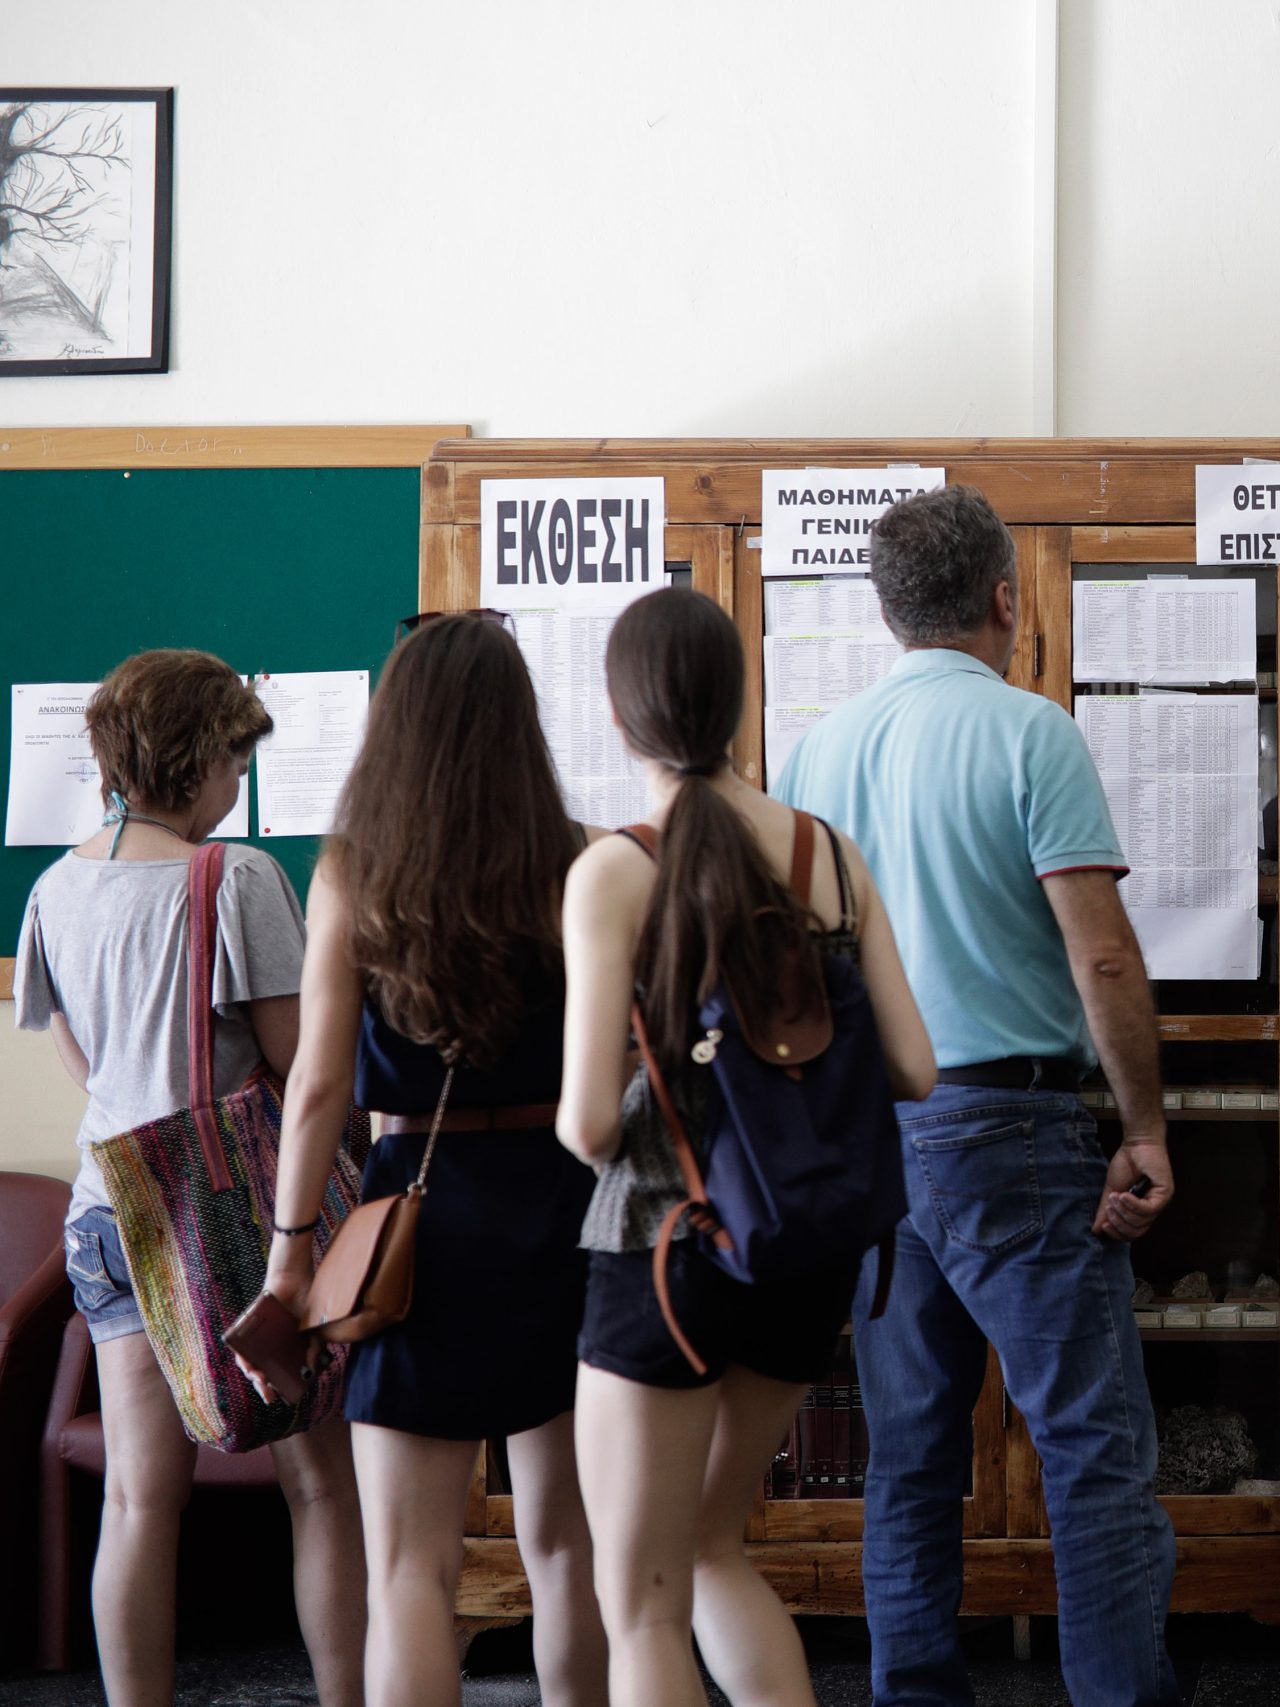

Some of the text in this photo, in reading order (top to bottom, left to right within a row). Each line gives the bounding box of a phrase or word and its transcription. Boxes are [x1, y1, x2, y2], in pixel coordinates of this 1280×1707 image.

[801, 518, 879, 535] ΓΕΝΙΚ
[497, 498, 650, 585] ΕΚΘΕΣΗ
[792, 548, 871, 565] ΠΑΙΔΕ
[38, 705, 87, 713] ΑΝΑΚΟΙΝΩΣ
